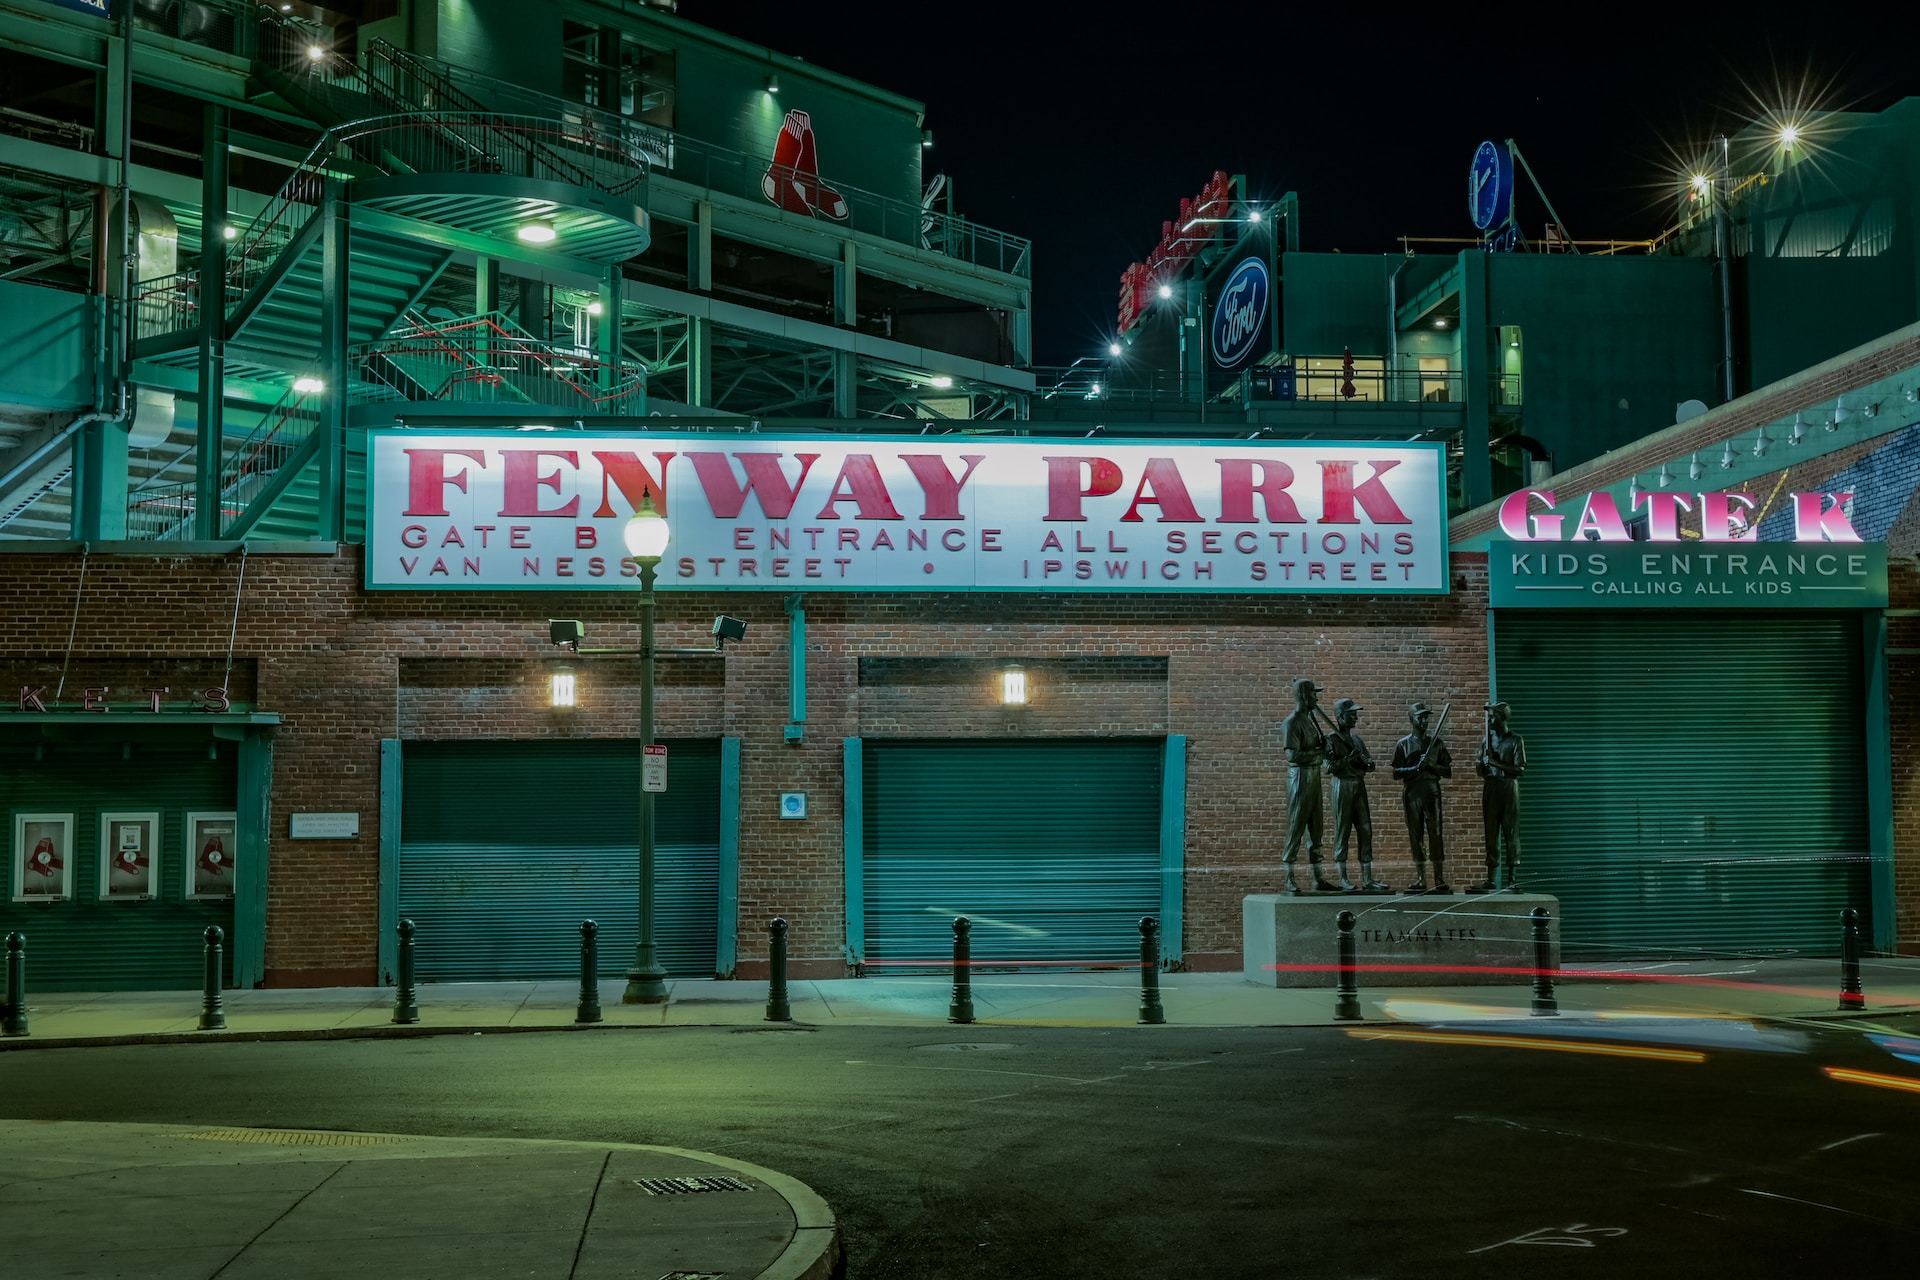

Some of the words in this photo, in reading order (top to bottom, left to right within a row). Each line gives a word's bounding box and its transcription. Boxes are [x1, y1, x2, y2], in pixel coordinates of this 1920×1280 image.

[1221, 276, 1257, 353] Ford
[403, 449, 986, 519] FENWAY
[1042, 456, 1413, 524] PARK
[1499, 488, 1758, 543] GATE
[1790, 491, 1864, 543] K
[401, 525, 532, 549] GATE
[576, 526, 598, 549] B
[734, 527, 1003, 552] ENTRANCE
[1041, 530, 1128, 553] ALL
[1167, 530, 1415, 555] SECTIONS
[399, 556, 481, 576] VAN
[523, 556, 640, 577] NESS
[677, 556, 852, 578] STREET
[1023, 559, 1213, 579] IPSWICH
[1251, 561, 1414, 581] STREET
[1511, 553, 1609, 576] KIDS
[1641, 554, 1868, 577] ENTRANCE
[1591, 581, 1683, 595] CALLING
[1694, 581, 1733, 595] ALL
[1745, 582, 1793, 595] KIDS
[1361, 928, 1477, 943] TEAMMATES
